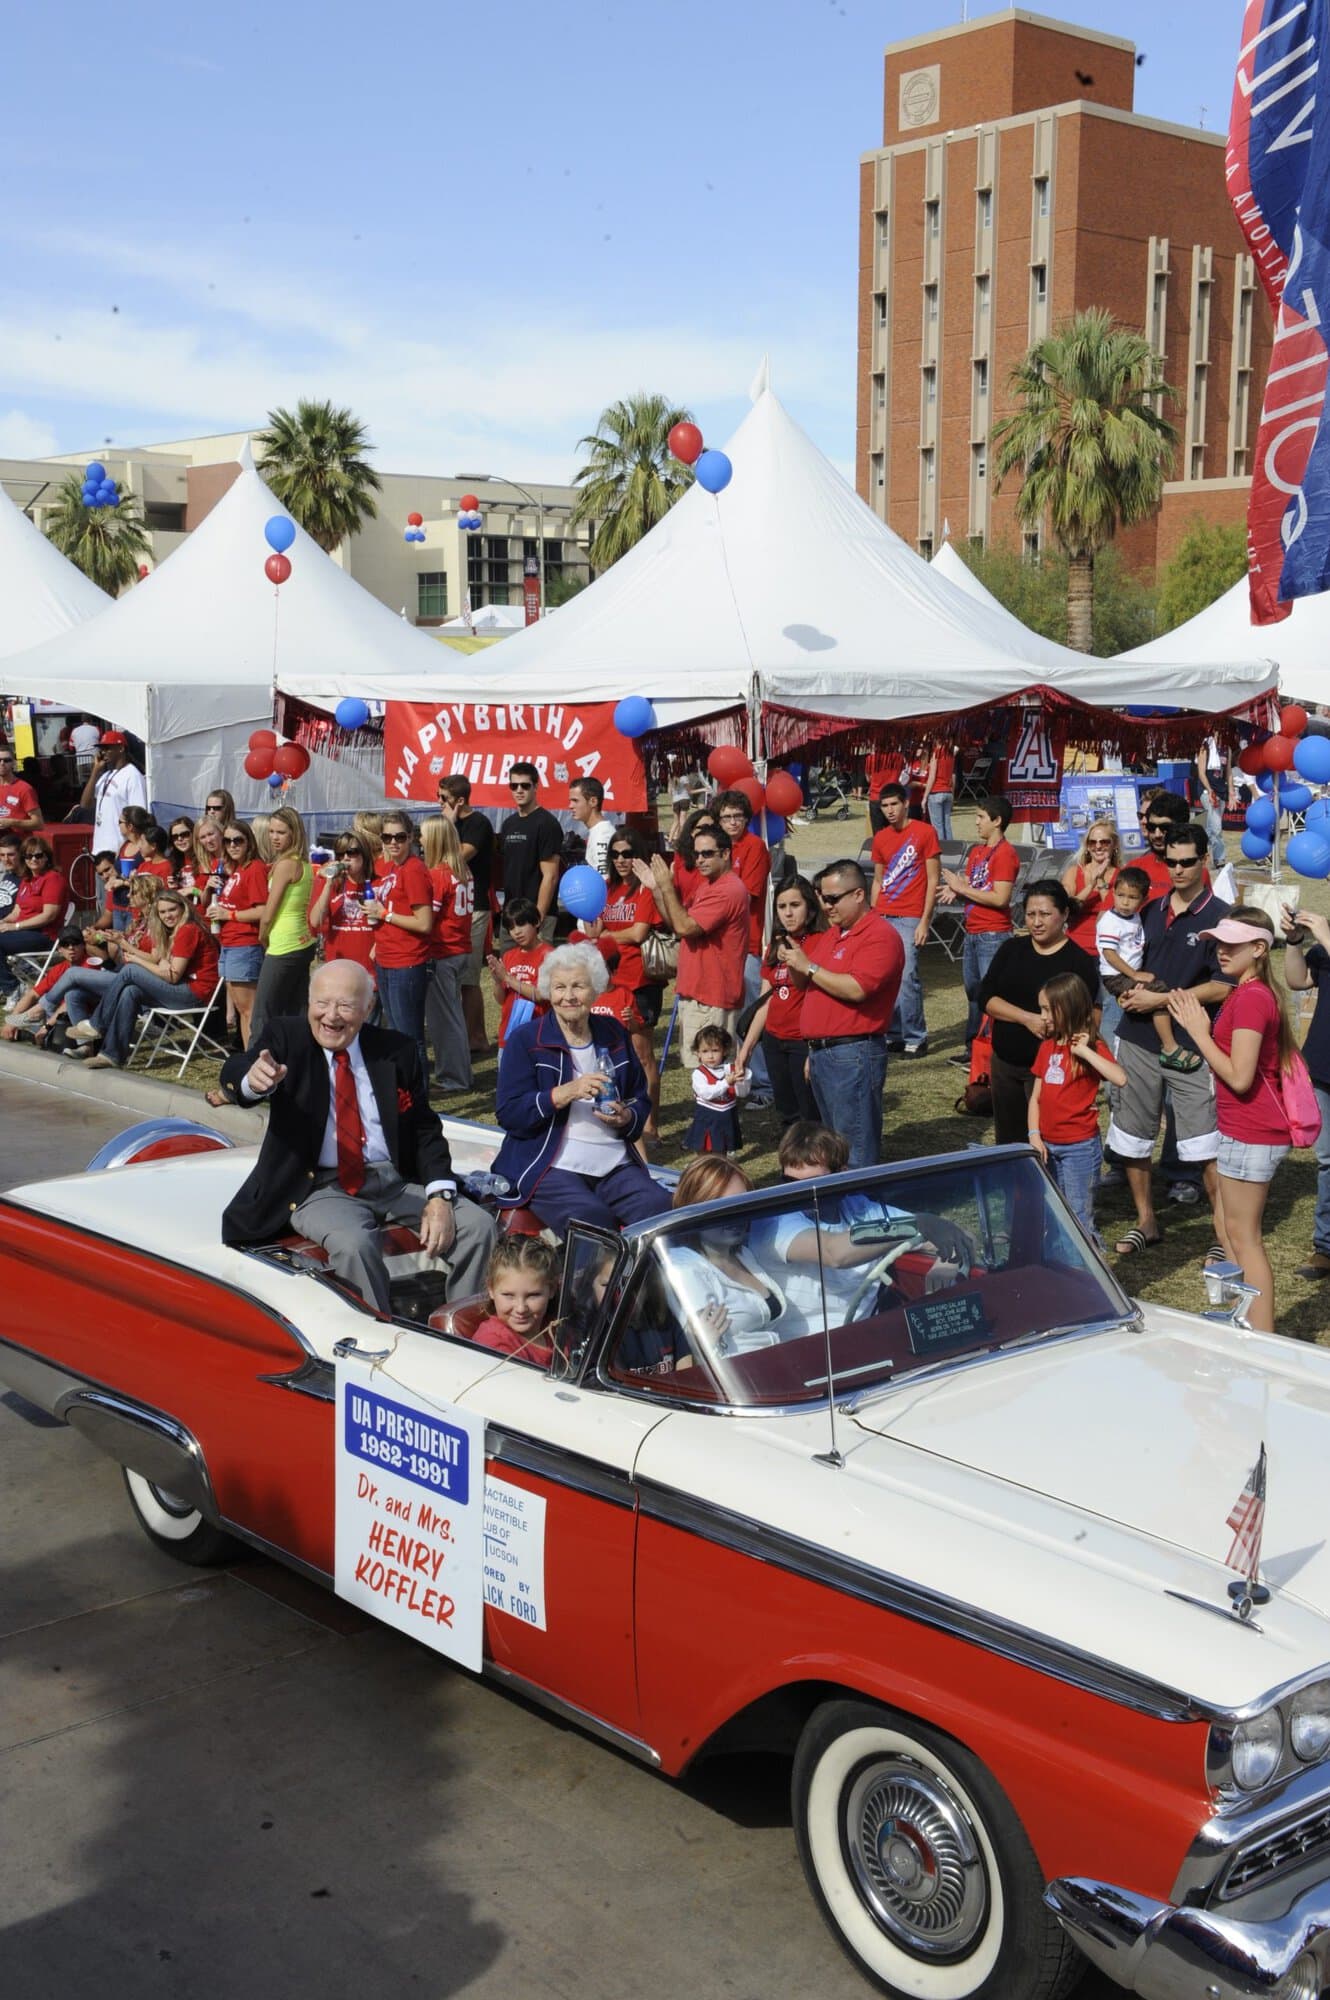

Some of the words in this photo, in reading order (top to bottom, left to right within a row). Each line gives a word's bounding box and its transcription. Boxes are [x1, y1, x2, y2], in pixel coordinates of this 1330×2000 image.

[393, 703, 467, 798] HAPPY
[450, 752, 549, 788] WiLBR
[352, 1395, 372, 1429] UA
[376, 1405, 460, 1466] PRESIDENT
[360, 1432, 451, 1490] 1982-1991
[358, 1473, 379, 1506] Dr.
[385, 1496, 413, 1523] and
[417, 1503, 455, 1544] Mrs.
[499, 1527, 511, 1540] OF
[369, 1520, 445, 1582] HENRY
[355, 1552, 456, 1630] KOFFLER
[511, 1595, 537, 1623] FORD
[519, 1581, 530, 1594] BY
